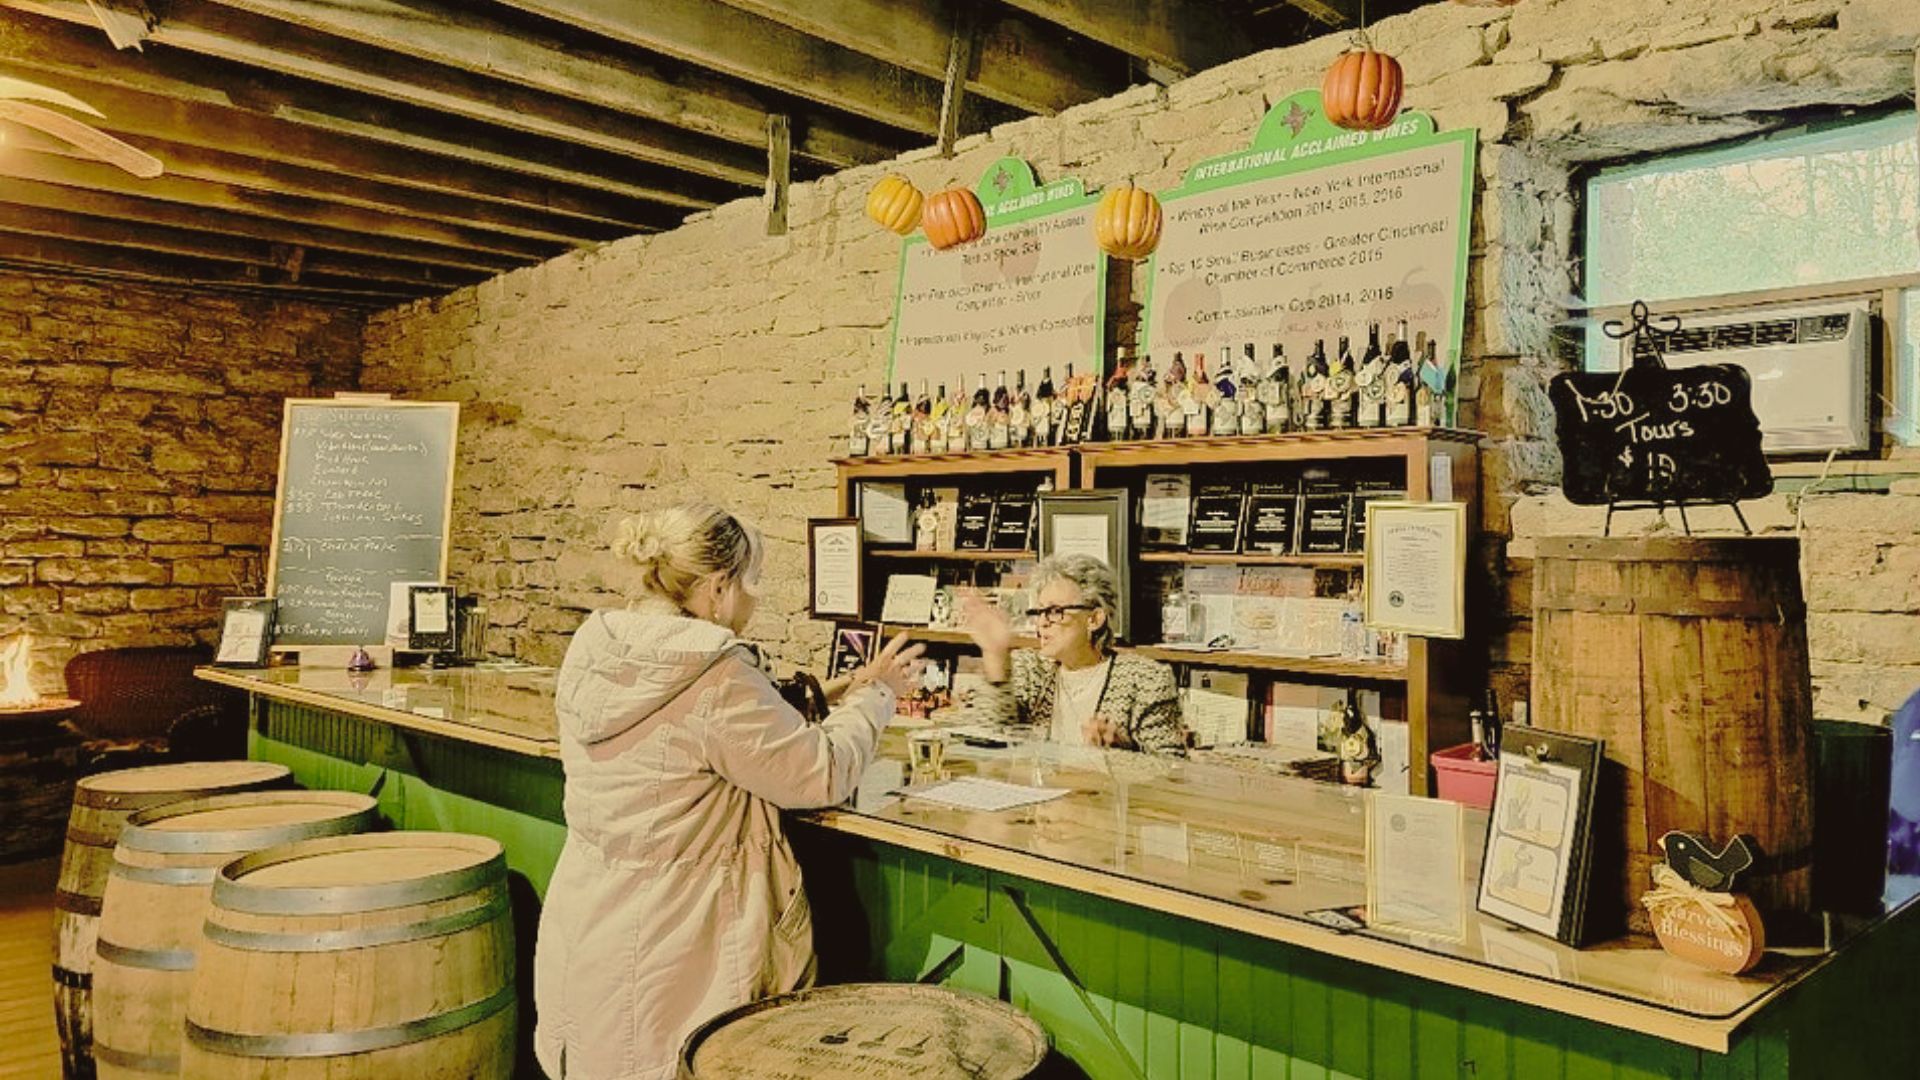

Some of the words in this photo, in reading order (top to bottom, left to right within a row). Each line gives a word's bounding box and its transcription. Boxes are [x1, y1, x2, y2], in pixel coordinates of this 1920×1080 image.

[1194, 148, 1286, 181] INTERNATIONAL
[1290, 130, 1366, 160] ACCLAIMED
[1373, 118, 1420, 143] WINES
[1294, 186, 1321, 200] New
[1326, 176, 1354, 192] York
[1358, 158, 1445, 188] International
[1323, 232, 1375, 251] Greater
[1377, 216, 1449, 242] Cincinnati
[1360, 286, 1394, 303] 2016
[1668, 381, 1731, 413] 3:30
[1615, 412, 1694, 443] Tours
[1661, 917, 1744, 958] Blessings
